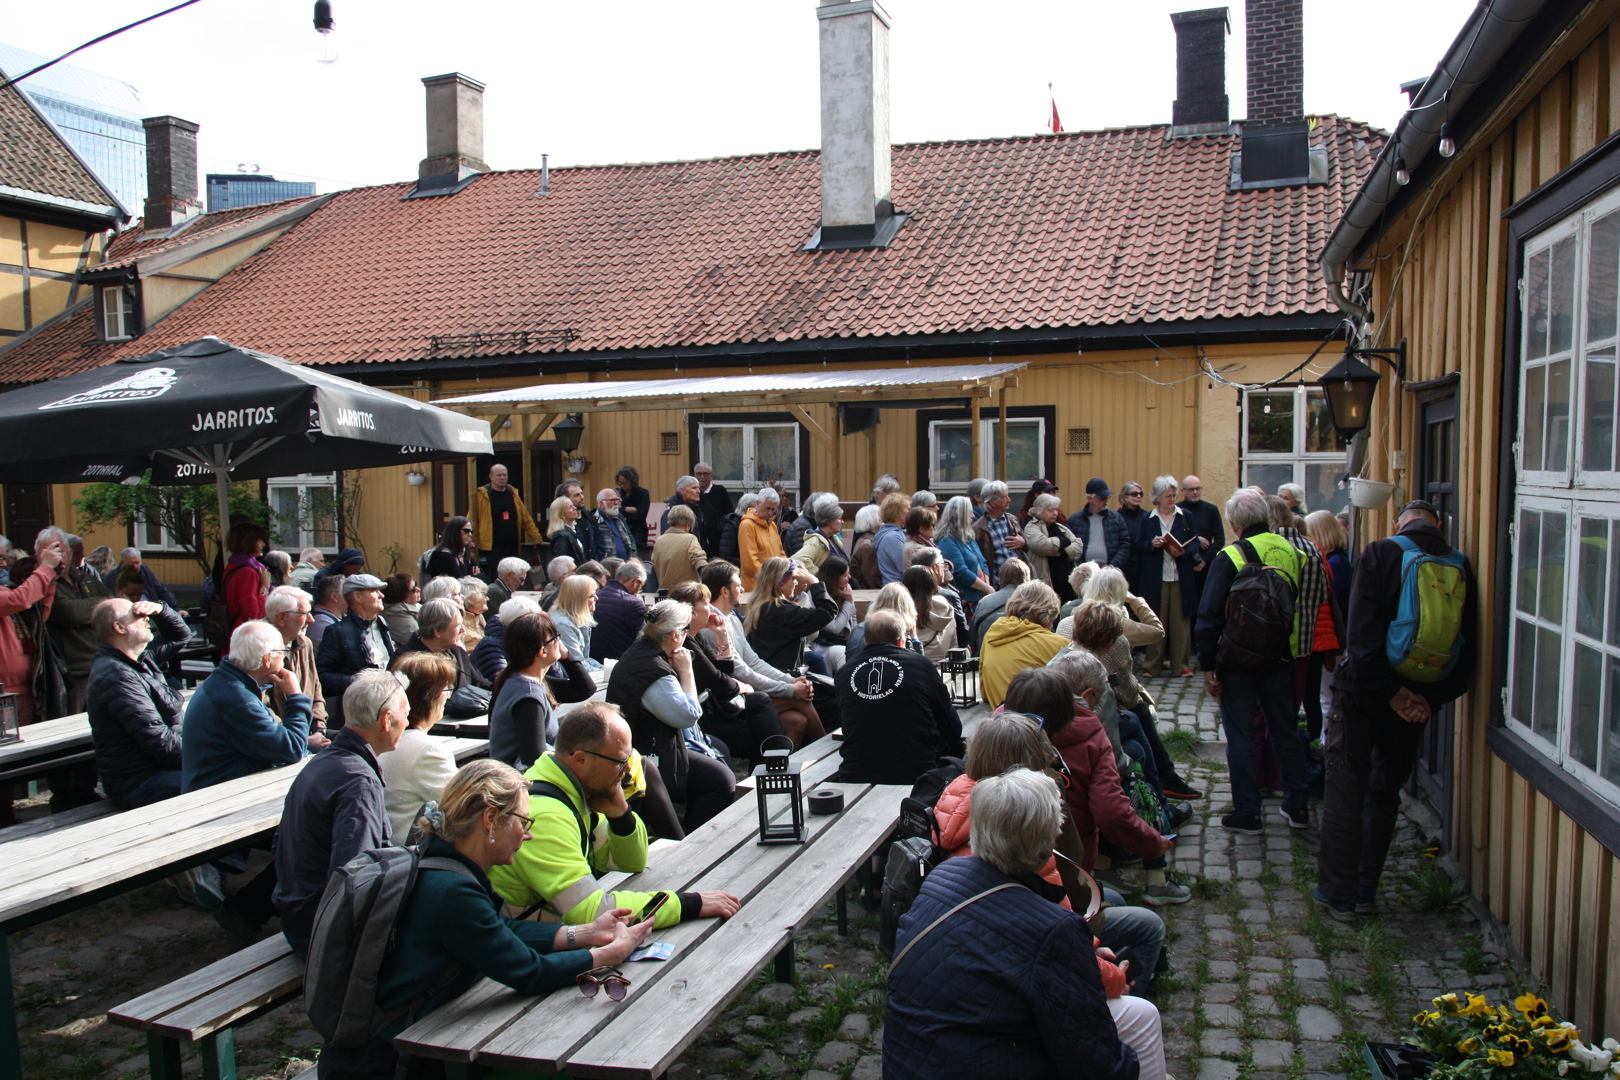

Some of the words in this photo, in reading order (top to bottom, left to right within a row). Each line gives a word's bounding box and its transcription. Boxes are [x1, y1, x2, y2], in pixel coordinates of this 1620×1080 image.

[192, 406, 276, 432] JARRITOS
[336, 407, 375, 430] JARRITOS
[857, 688, 893, 700] HISTORIELAG
